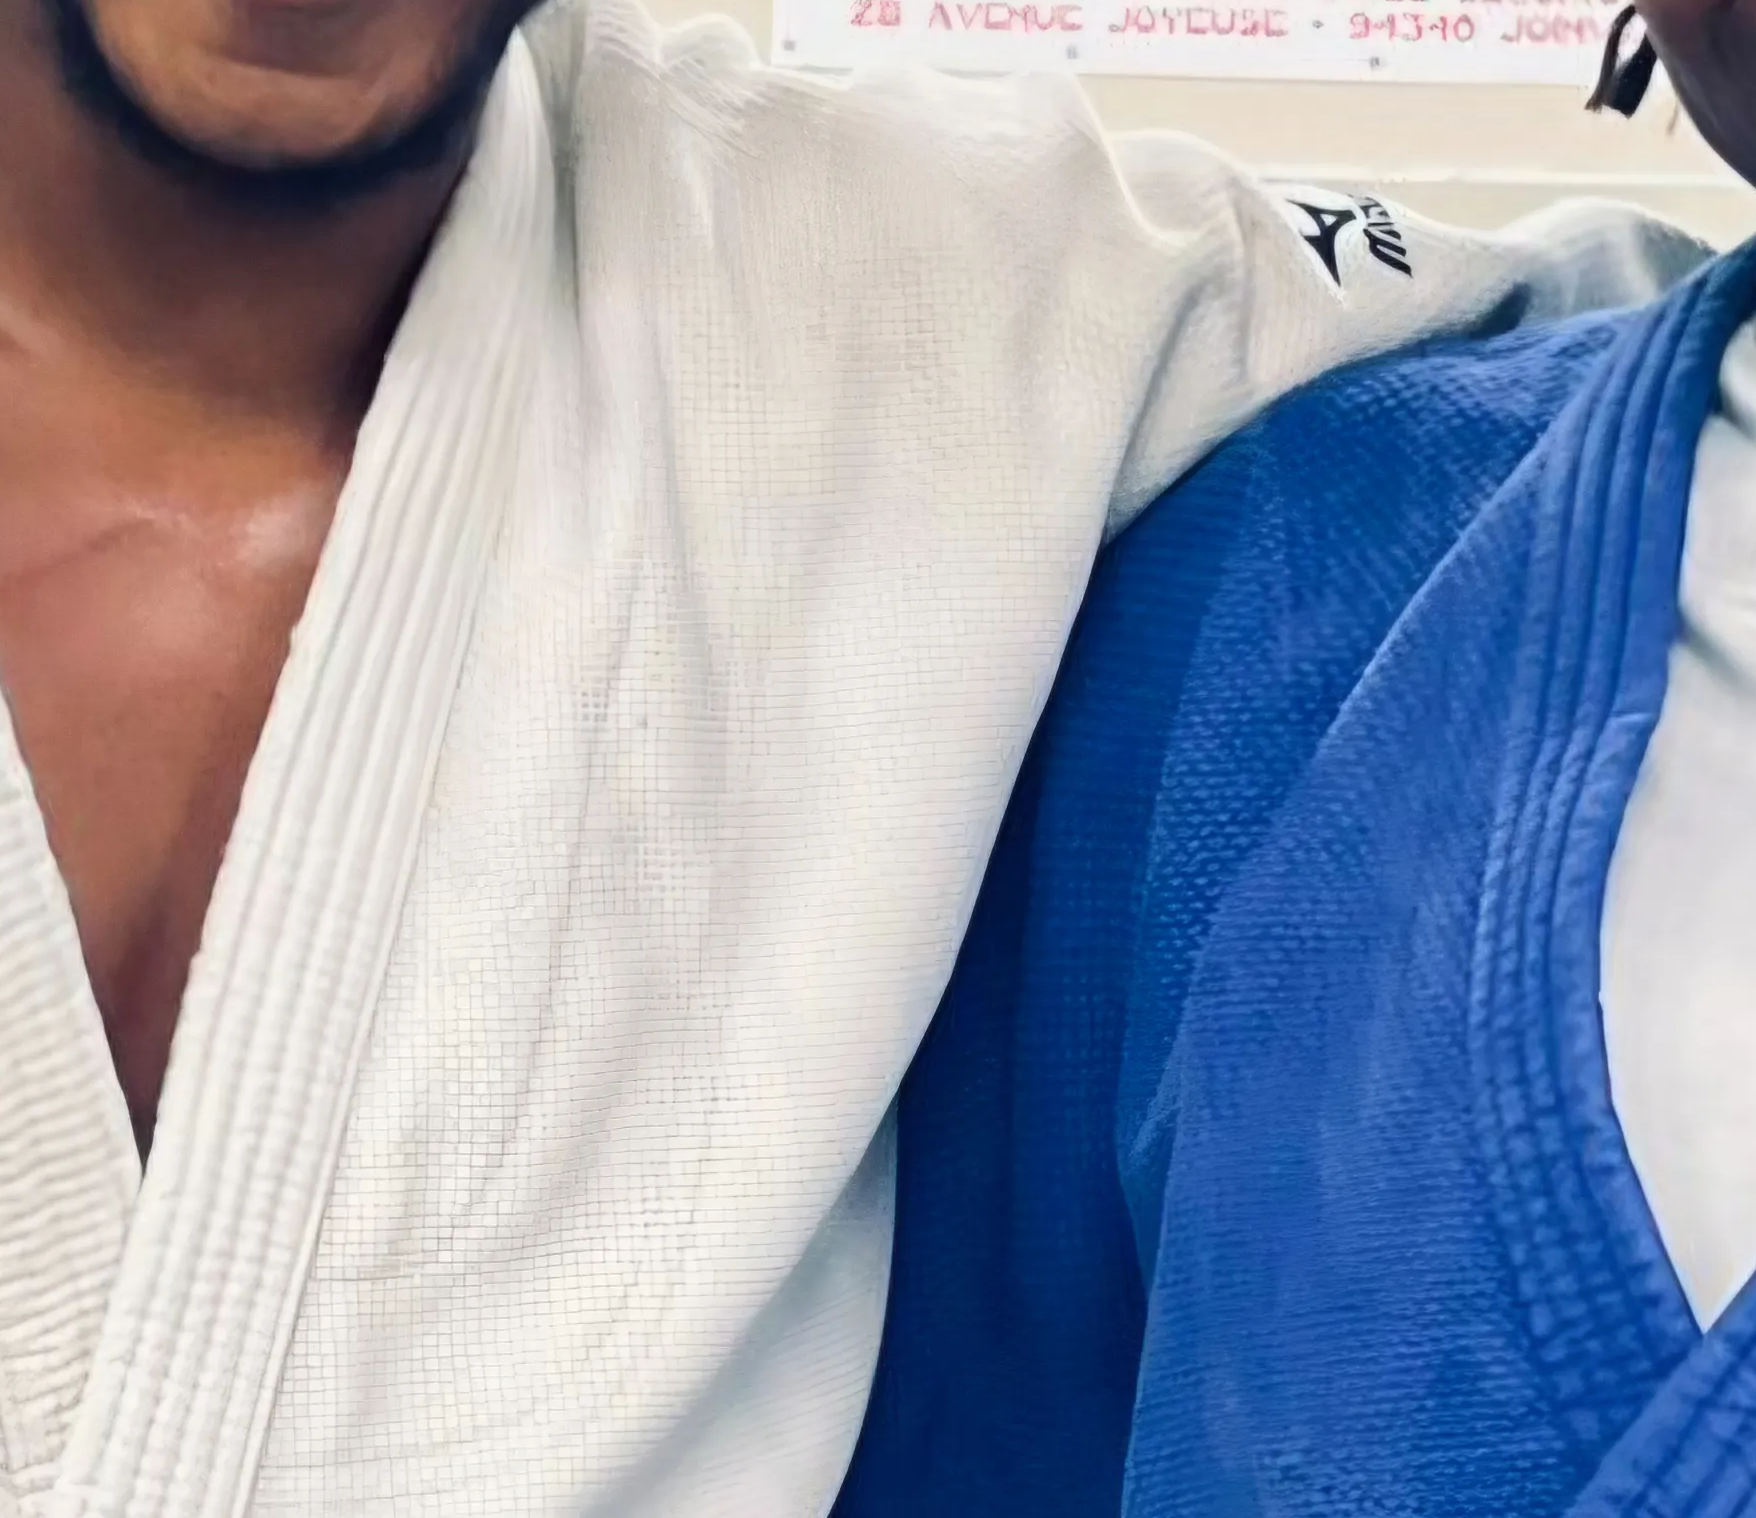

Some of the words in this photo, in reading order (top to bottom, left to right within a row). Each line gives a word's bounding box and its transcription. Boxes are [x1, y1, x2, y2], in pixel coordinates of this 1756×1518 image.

[928, 1, 1084, 32] AVENUE
[1107, 7, 1288, 37] JOYEUSE
[1348, 12, 1477, 43] 94340
